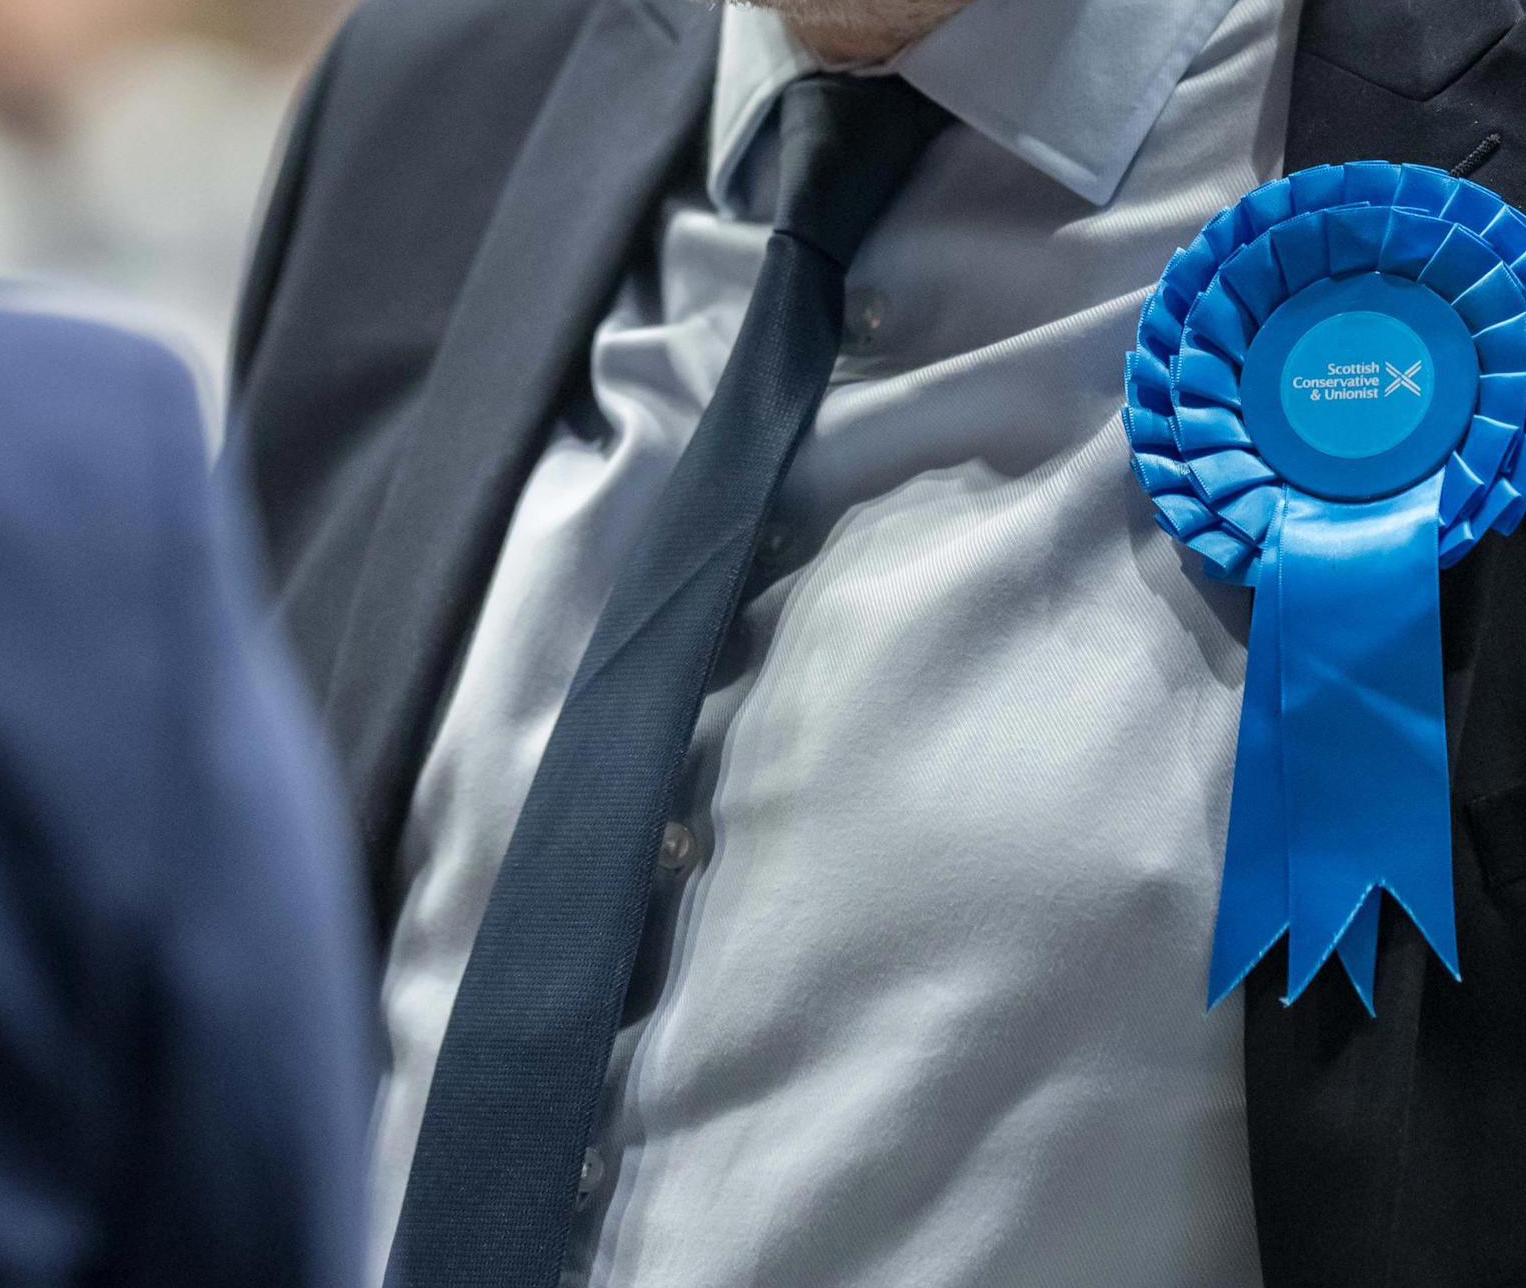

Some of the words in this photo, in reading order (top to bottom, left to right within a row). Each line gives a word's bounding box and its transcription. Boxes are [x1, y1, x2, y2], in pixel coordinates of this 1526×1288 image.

[1328, 362, 1380, 376] Scottish
[1292, 375, 1380, 389] Conservative
[1310, 390, 1321, 401] &
[1324, 388, 1379, 401] Unionist
